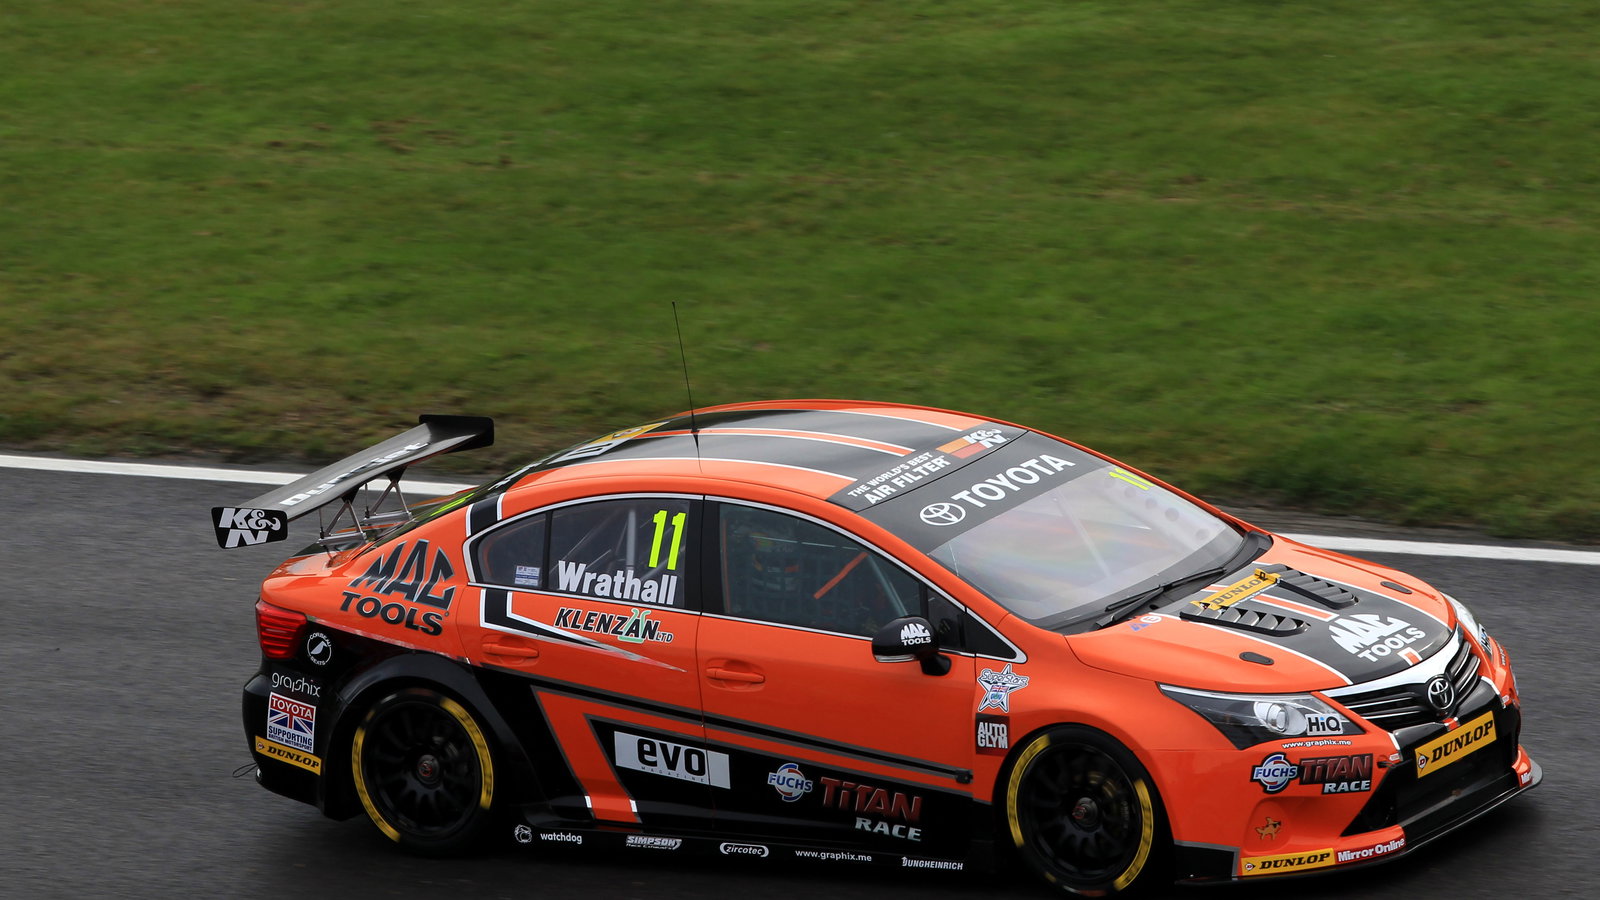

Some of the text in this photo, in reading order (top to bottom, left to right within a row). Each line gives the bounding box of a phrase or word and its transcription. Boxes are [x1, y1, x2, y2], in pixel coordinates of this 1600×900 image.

[848, 452, 934, 498] THE WORLD'S BEST
[864, 459, 951, 504] AIR FILTER
[951, 454, 1076, 508] TOYOTA
[649, 510, 686, 570] 11
[346, 539, 456, 611] MAC
[558, 560, 678, 605] Wrathall
[340, 590, 444, 636] TOOLS
[555, 607, 673, 643] KLENZAN LTD
[901, 623, 931, 640] MAC
[1328, 613, 1411, 655] MAC
[902, 637, 932, 646] TOOLS
[1357, 627, 1426, 662] TOOLS
[272, 672, 320, 697] graphix
[271, 697, 313, 719] TOYOTA
[978, 721, 1007, 736] AUTO
[1307, 716, 1341, 732] HiQ
[268, 726, 313, 746] SUPPORTING
[978, 734, 1008, 749] GLYM
[1281, 739, 1352, 749] www.graphix.me
[1431, 720, 1493, 764] DUNLOP
[267, 745, 320, 769] DUNLOP
[637, 738, 706, 777] evo
[641, 766, 705, 783] MAGAZINE
[768, 774, 812, 792] FUCHS
[1254, 767, 1297, 778] FUCHS
[1324, 780, 1371, 793] RACE
[540, 832, 583, 844] watchdog
[855, 817, 922, 842] RACE
[627, 836, 675, 847] SIMPSON
[726, 845, 763, 856] zircotec
[1338, 838, 1405, 862] Mirror Online
[795, 850, 872, 862] www.graphix.me
[1259, 852, 1331, 870] DUNLOP
